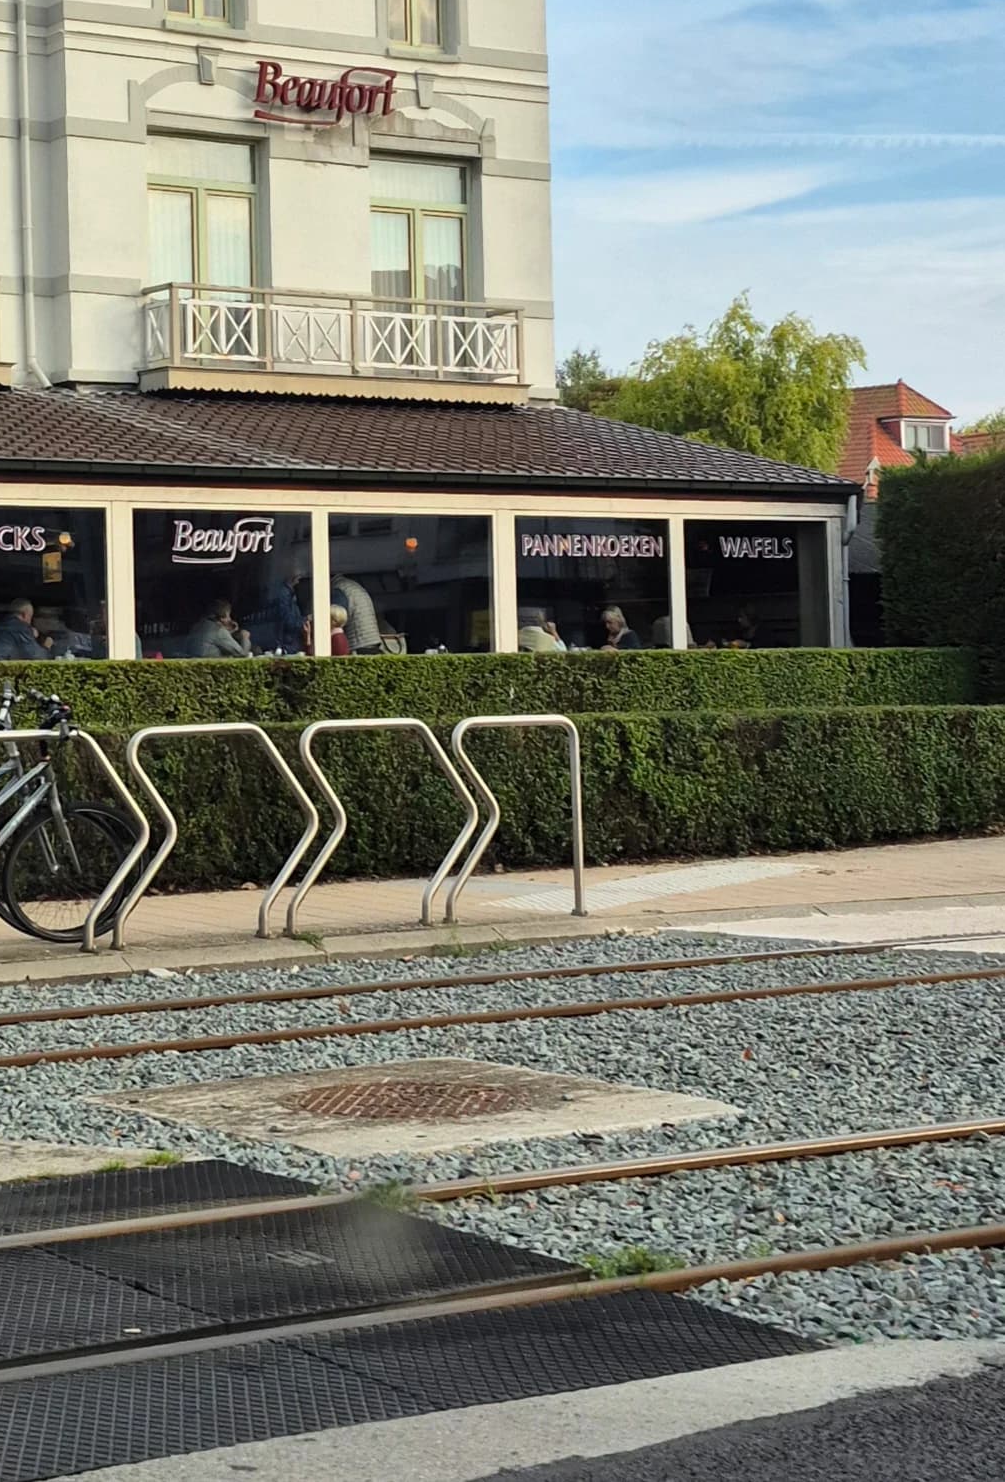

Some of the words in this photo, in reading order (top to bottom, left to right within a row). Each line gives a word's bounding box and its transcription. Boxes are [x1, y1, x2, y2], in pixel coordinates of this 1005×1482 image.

[253, 60, 397, 125] Beaufort
[172, 517, 275, 564] Beaufort
[521, 533, 664, 558] PANNENKOEKEN
[718, 536, 793, 558] WAFELS
